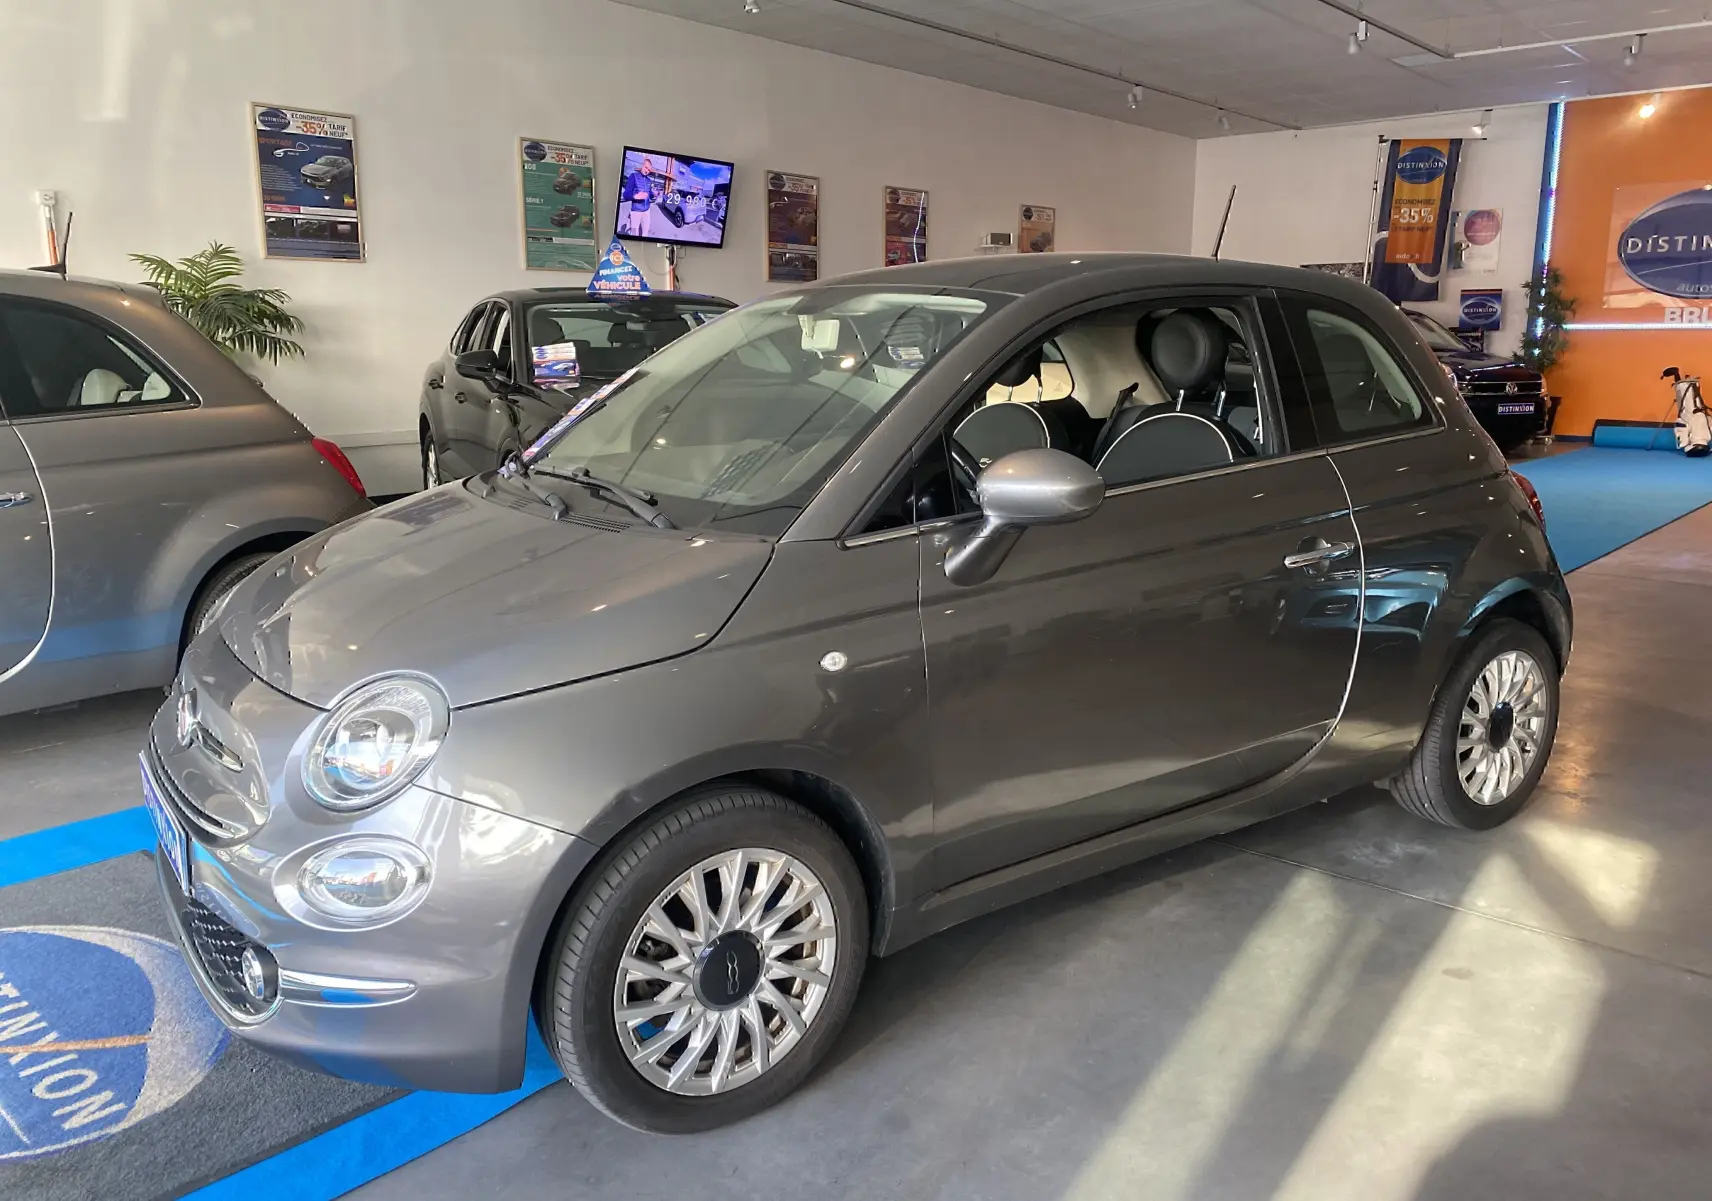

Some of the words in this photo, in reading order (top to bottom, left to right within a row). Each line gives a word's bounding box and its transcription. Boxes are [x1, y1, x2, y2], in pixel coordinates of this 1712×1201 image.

[291, 112, 327, 123] ECONOMISEZ
[295, 120, 328, 136] -35%
[328, 123, 347, 132] TARIF
[1397, 161, 1444, 170] DISTINXION
[666, 193, 681, 205] 29
[686, 195, 706, 208] 980
[599, 266, 633, 277] FINANCEZ
[616, 275, 641, 283] votre
[593, 280, 641, 291] VÉHICULE
